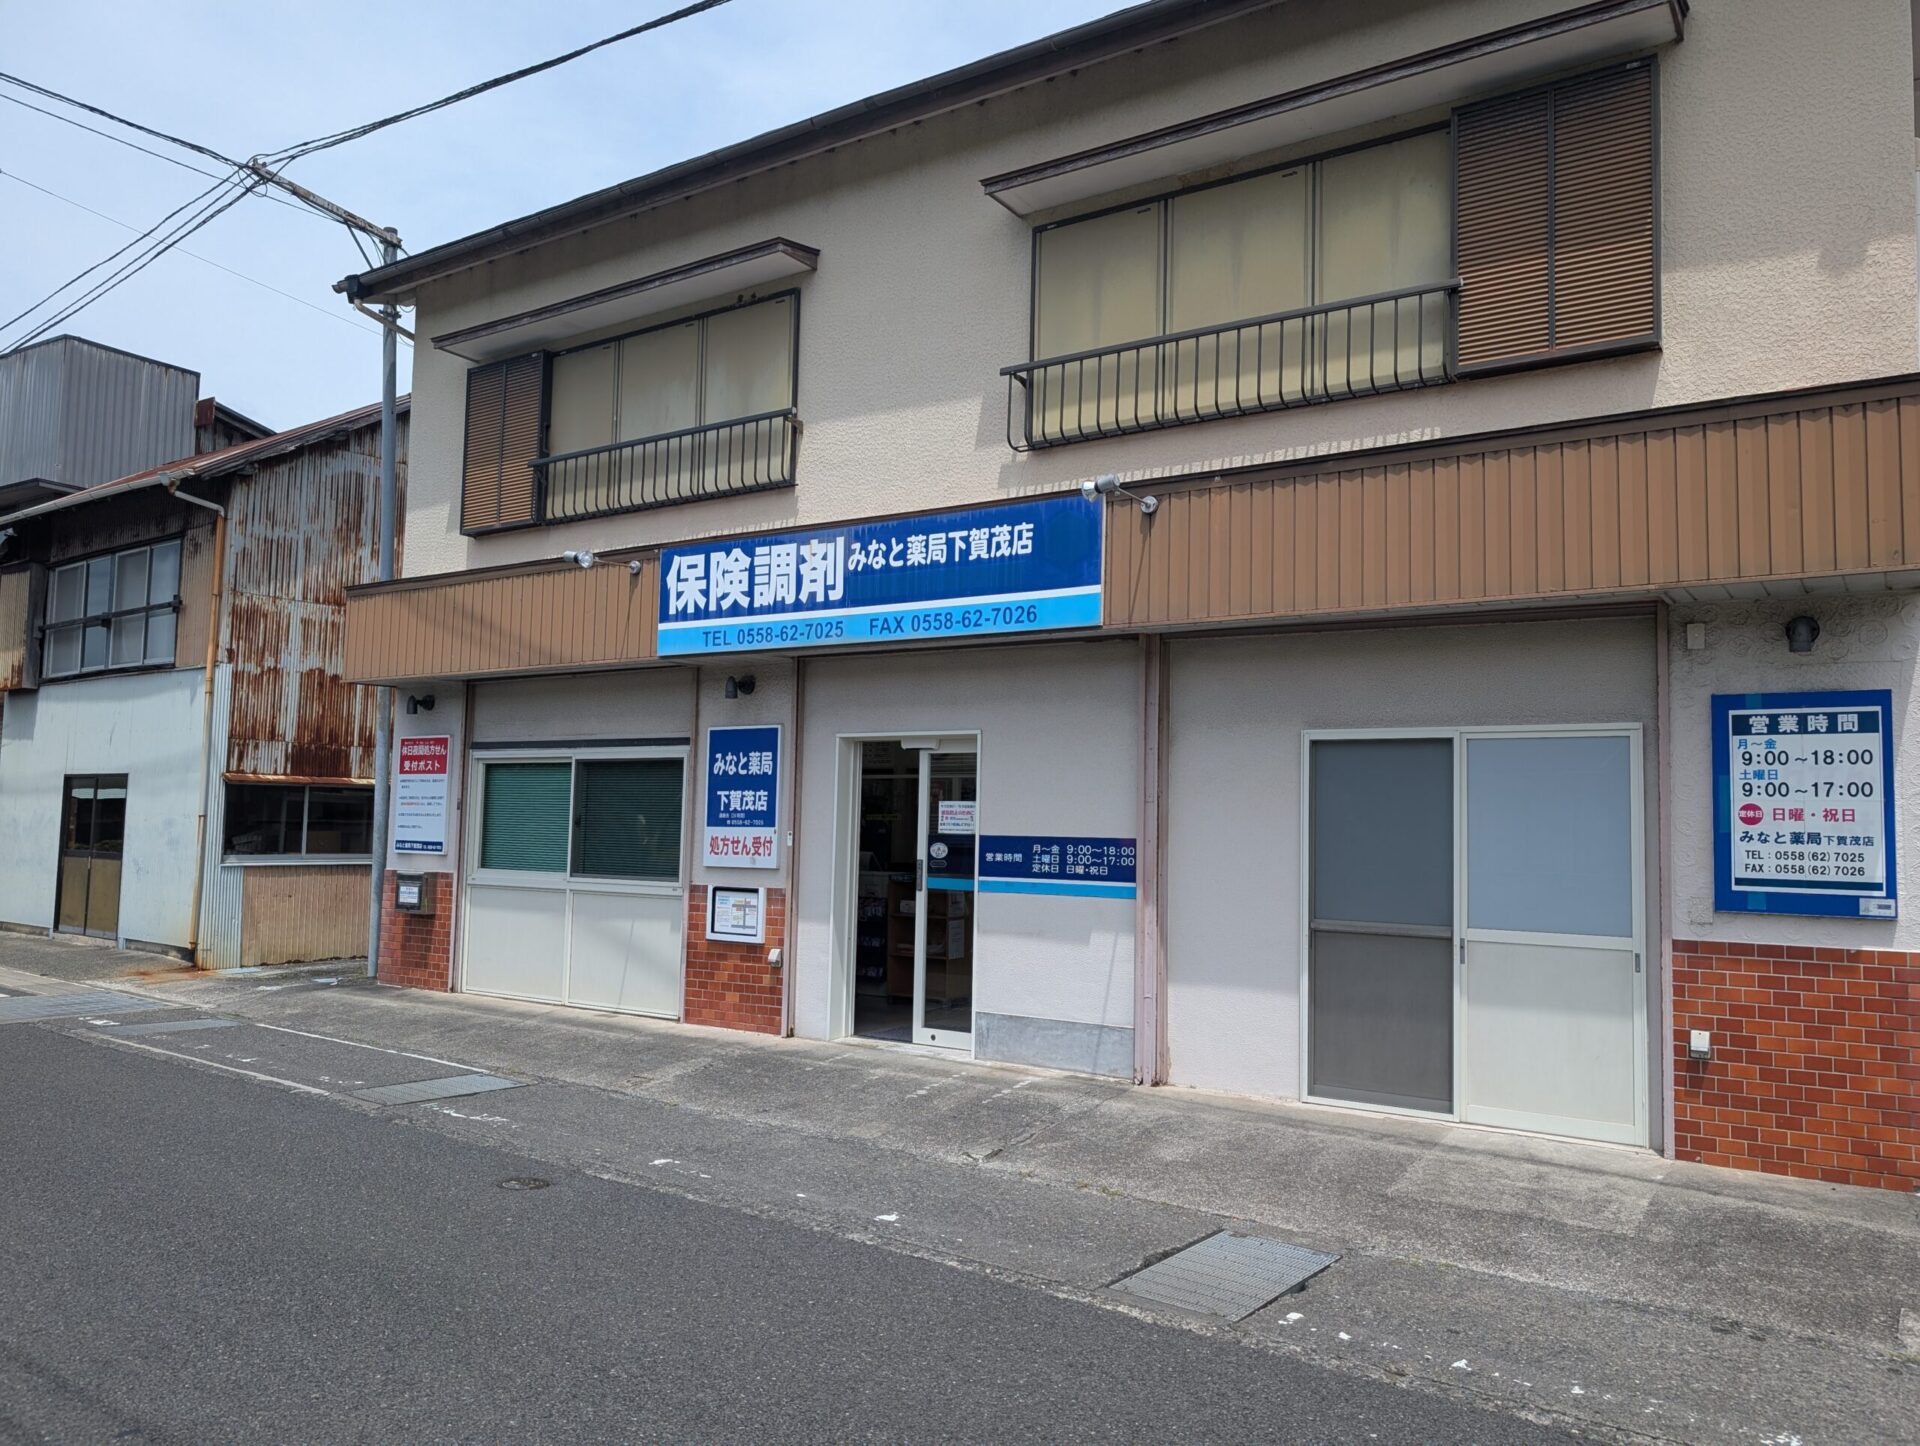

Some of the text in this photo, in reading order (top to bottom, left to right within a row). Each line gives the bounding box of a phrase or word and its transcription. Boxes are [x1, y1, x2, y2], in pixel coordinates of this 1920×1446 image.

[666, 522, 1034, 615] 保険調剤 みなと薬局下賀茂店
[702, 604, 1038, 648] TEL 0558-62-7025 FAX 0558-62-7026
[1748, 713, 1859, 735] 営業時間
[403, 760, 441, 772] 受付ポスト
[713, 751, 773, 776] みなと薬局
[1739, 769, 1778, 781] 土曜日
[716, 789, 768, 812] 下賀茂店
[1738, 810, 1763, 819] 定休日
[709, 835, 773, 857] 処方せん受付
[1739, 830, 1875, 847] みなと薬局下賀茂店
[985, 852, 1023, 863] 営業時間
[1032, 855, 1060, 864] 土曜日
[1032, 864, 1108, 876] 定休日 日曜・祝日
